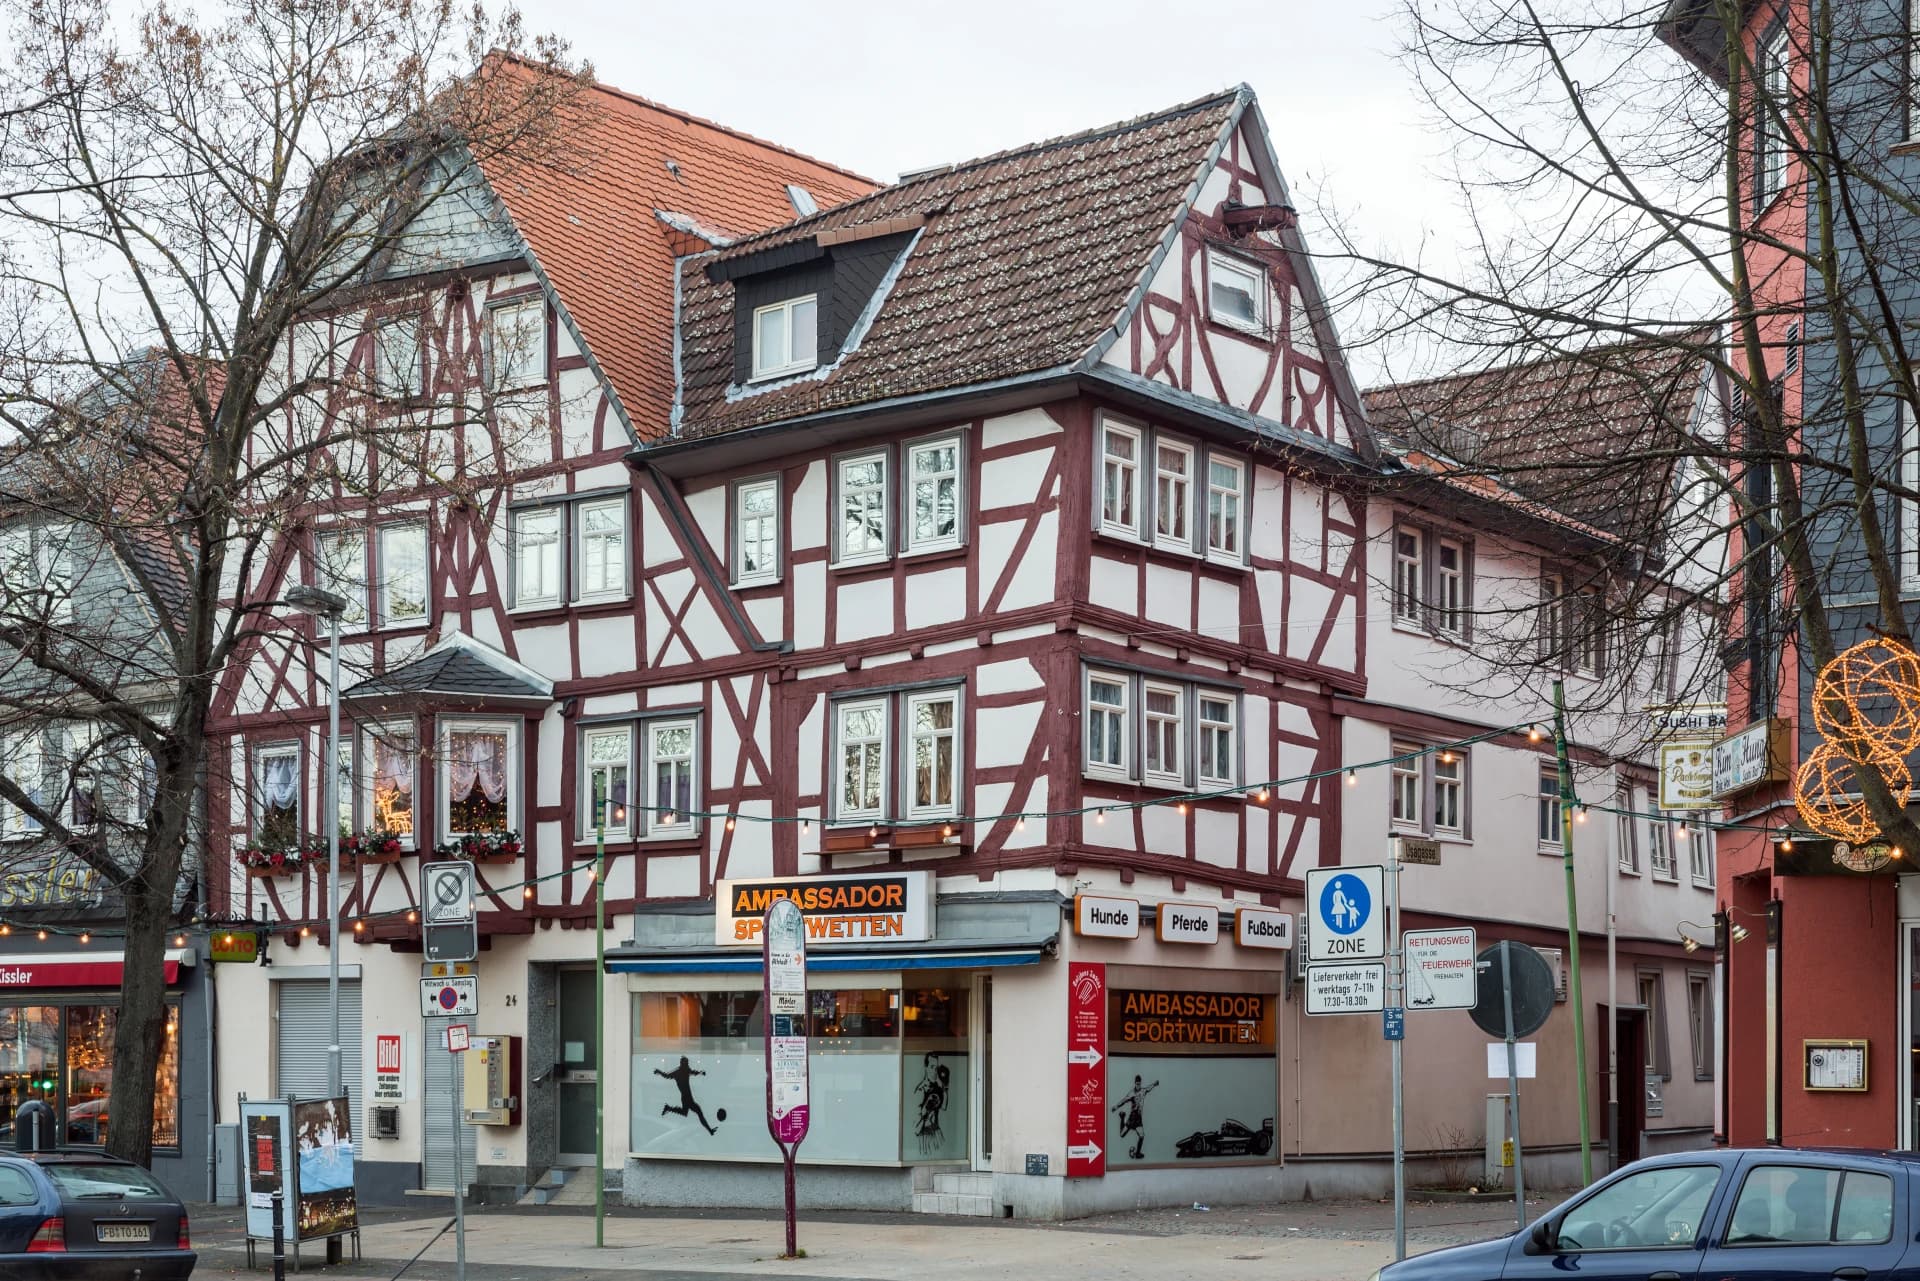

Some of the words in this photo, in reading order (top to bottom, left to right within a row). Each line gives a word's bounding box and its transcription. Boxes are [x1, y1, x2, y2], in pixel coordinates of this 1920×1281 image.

[1658, 717, 1702, 728] SUSHI
[1708, 715, 1728, 728] BA
[1091, 907, 1129, 926] Hunde
[1172, 914, 1209, 933] Pferde
[734, 914, 904, 940] SPWETTEN
[1247, 919, 1286, 938] Fußball
[212, 937, 254, 953] LOTTO
[1327, 938, 1366, 954] ZONE
[1408, 935, 1471, 948] RETTUNGSWEG
[1422, 958, 1473, 970] FEUERWEHR
[1313, 970, 1362, 983] Lieferverkehr
[1365, 969, 1379, 980] frei
[1317, 984, 1351, 997] werktags
[1354, 982, 1374, 993] 7-11h
[505, 995, 518, 1007] 24
[1124, 992, 1261, 1018] AMBASSADOR
[1323, 996, 1368, 1008] 17.30-18.30h
[1123, 1020, 1262, 1044] SPORTWETTEN
[378, 1039, 399, 1069] Bild
